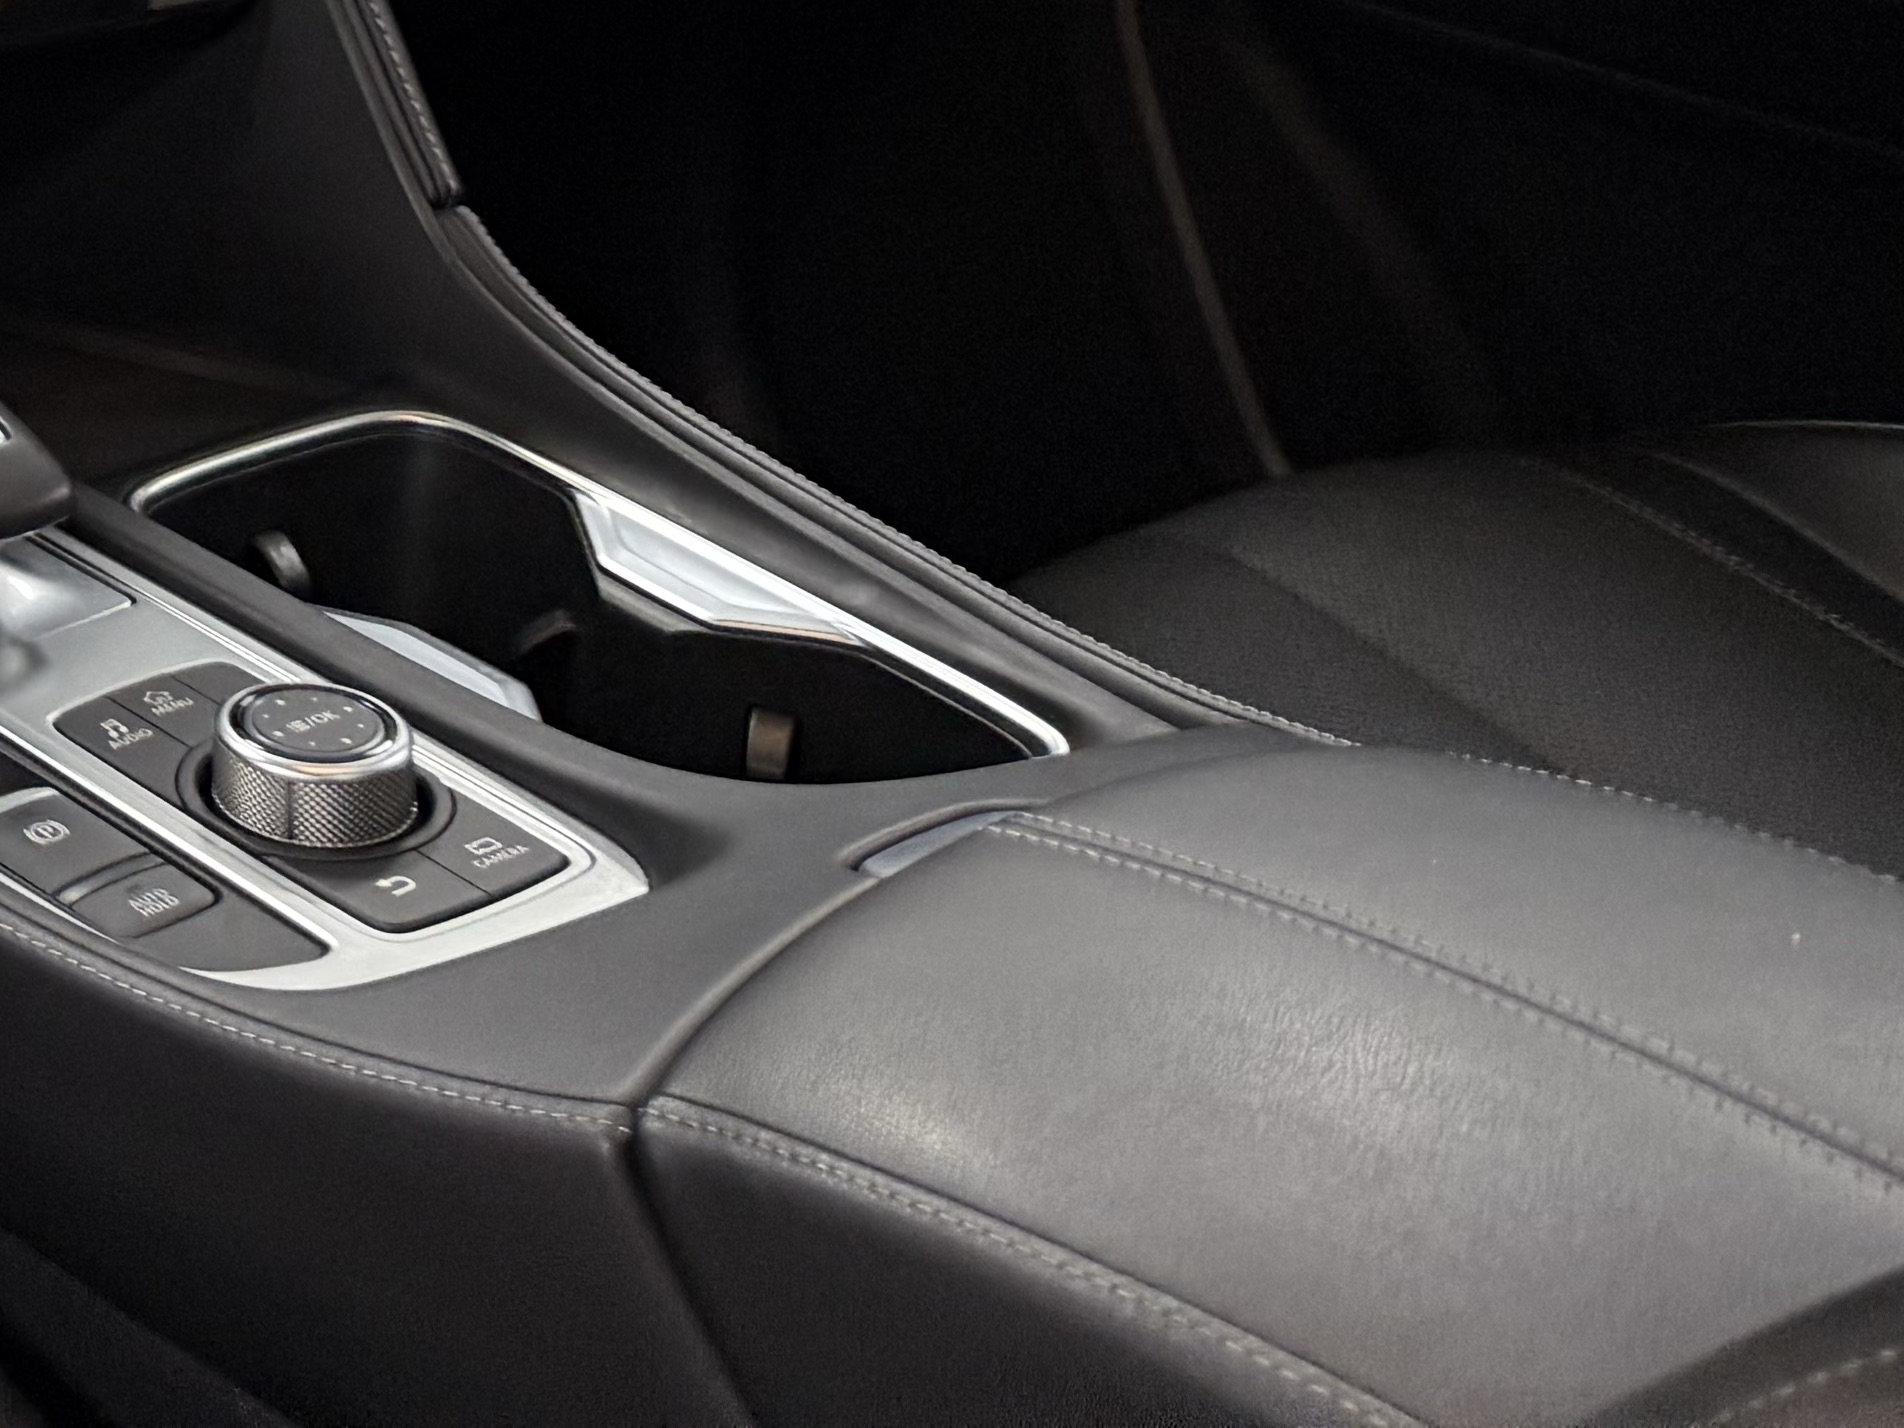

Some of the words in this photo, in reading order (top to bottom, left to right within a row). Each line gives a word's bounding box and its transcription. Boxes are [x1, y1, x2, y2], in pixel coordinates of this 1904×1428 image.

[152, 697, 195, 716] MENU
[109, 727, 153, 750] AUDIO
[473, 845, 529, 869] CAMERA
[128, 888, 169, 911] AUTO
[139, 896, 180, 918] HOLD
